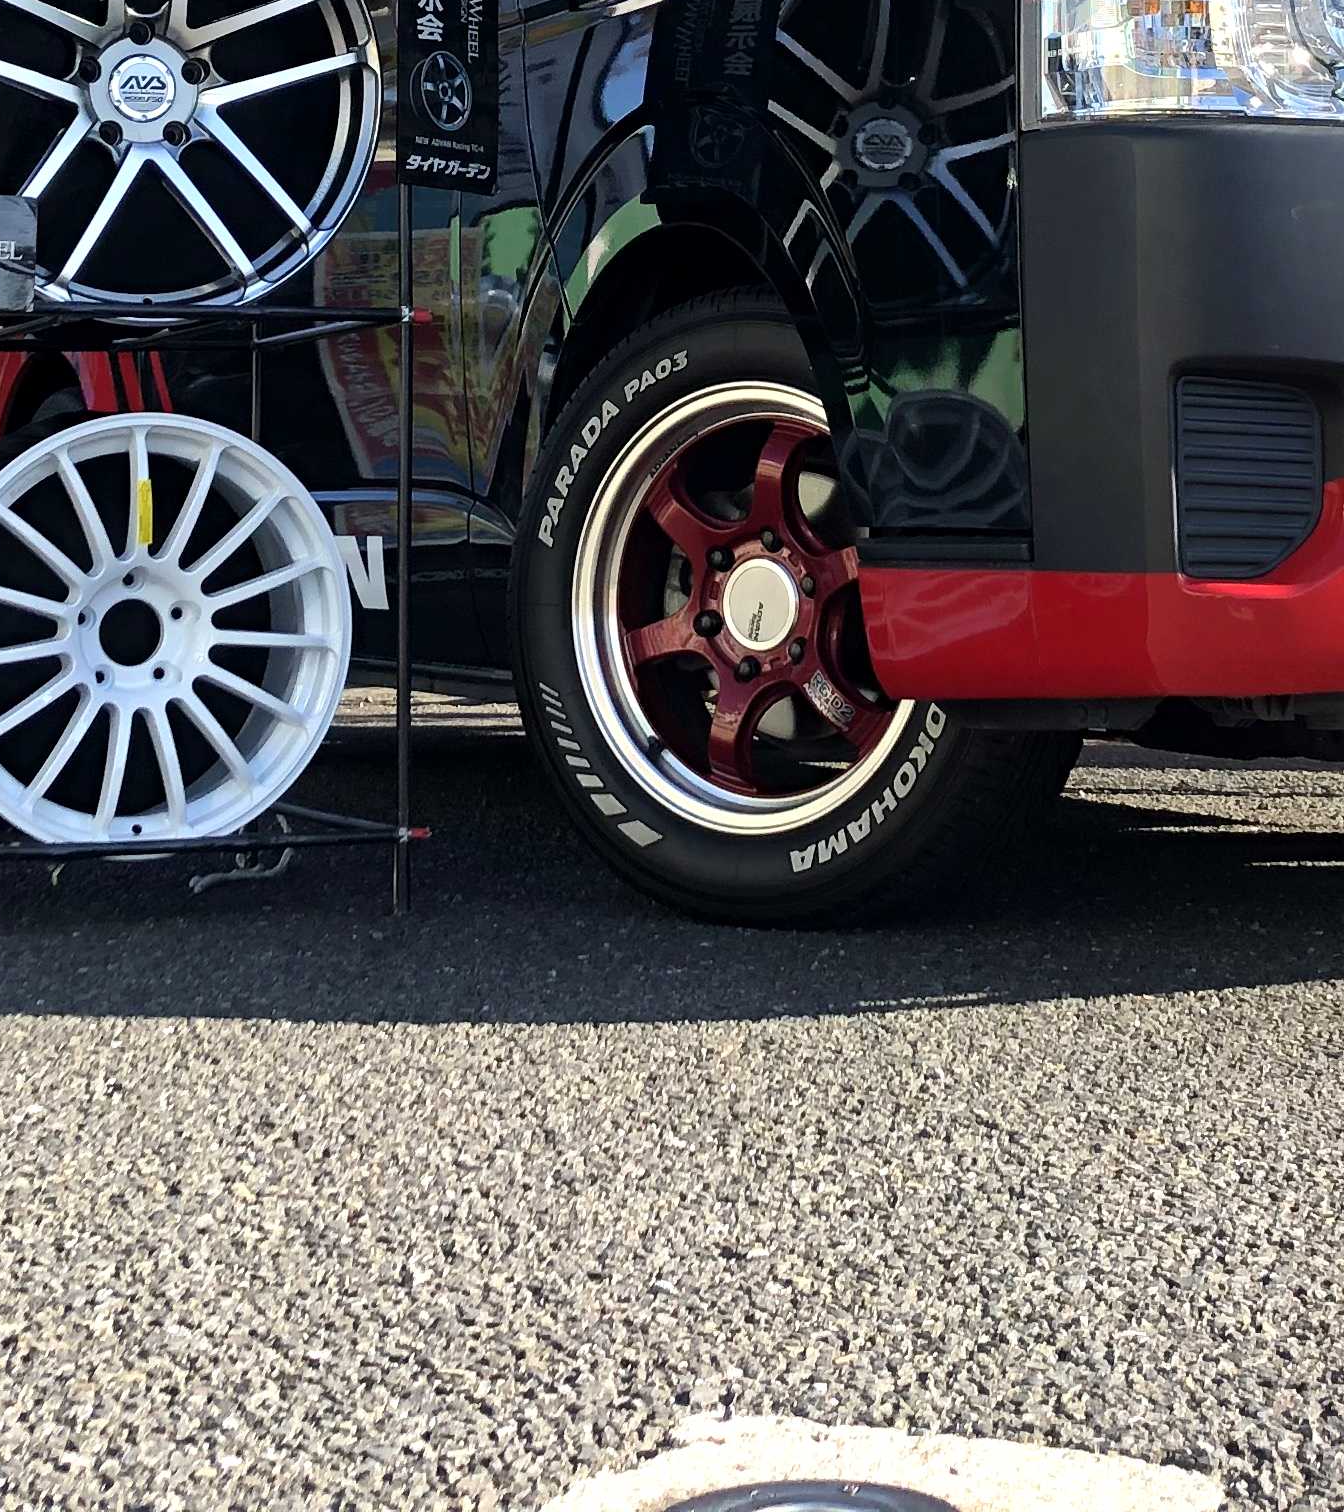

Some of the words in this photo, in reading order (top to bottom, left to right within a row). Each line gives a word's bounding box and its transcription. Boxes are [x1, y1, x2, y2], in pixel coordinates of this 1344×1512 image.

[119, 75, 168, 91] AVS
[405, 154, 491, 180] タイヤガーデン
[538, 399, 620, 548] PARADA
[623, 350, 688, 403] PA03
[789, 702, 947, 873] OKOHAMA
